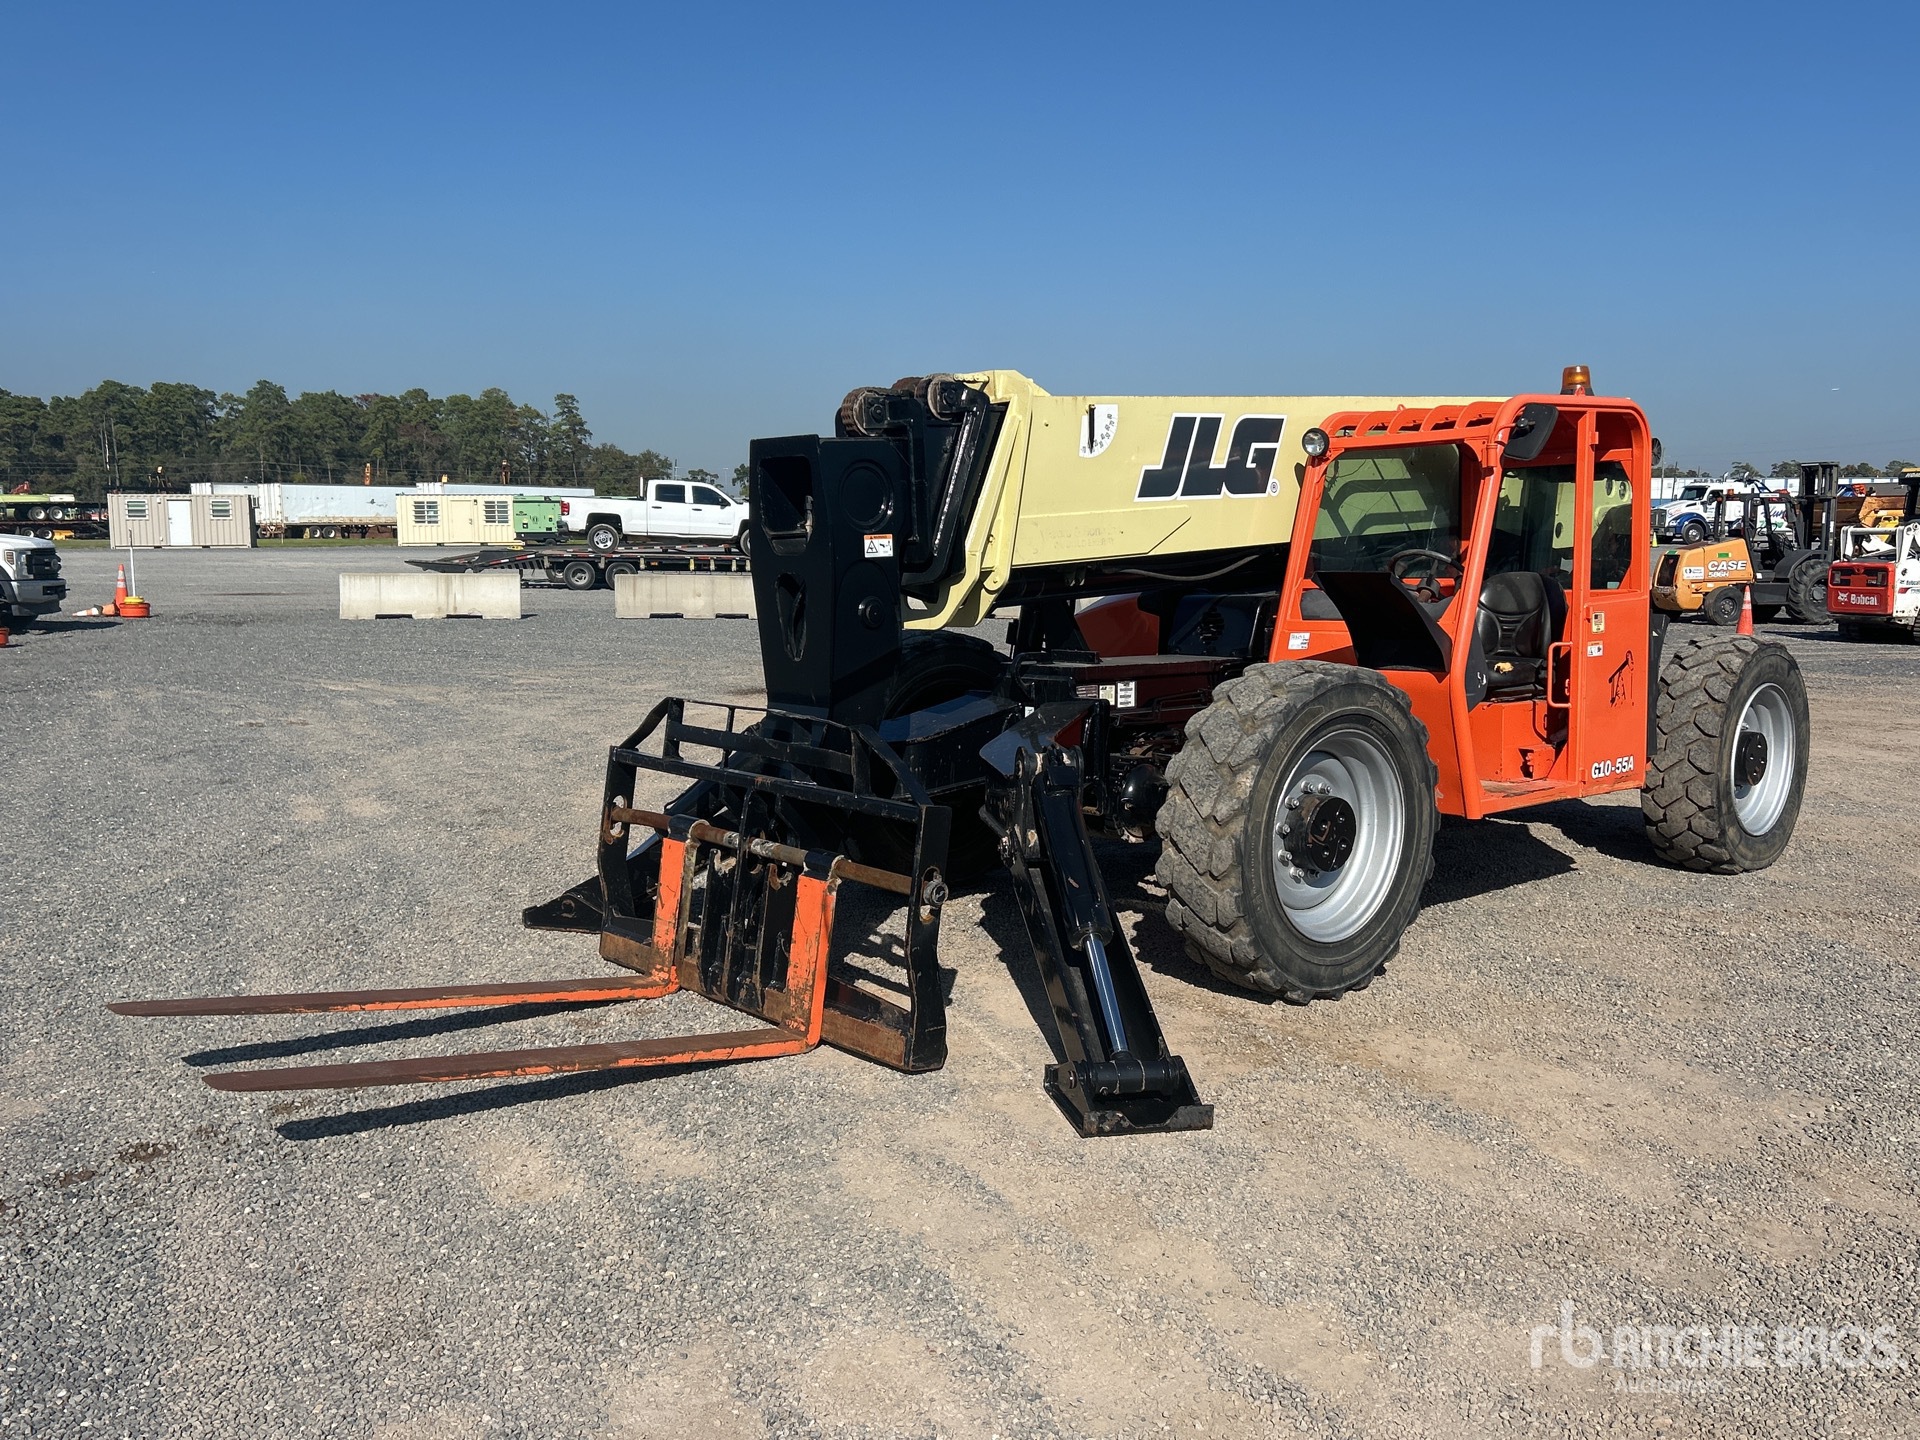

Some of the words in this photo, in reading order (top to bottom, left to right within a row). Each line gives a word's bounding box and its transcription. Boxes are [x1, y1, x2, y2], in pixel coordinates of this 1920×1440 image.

[1136, 414, 1286, 500] JLG
[1707, 560, 1748, 571] CASE
[1850, 593, 1878, 606] Bobcat
[1591, 755, 1634, 779] G10-55A
